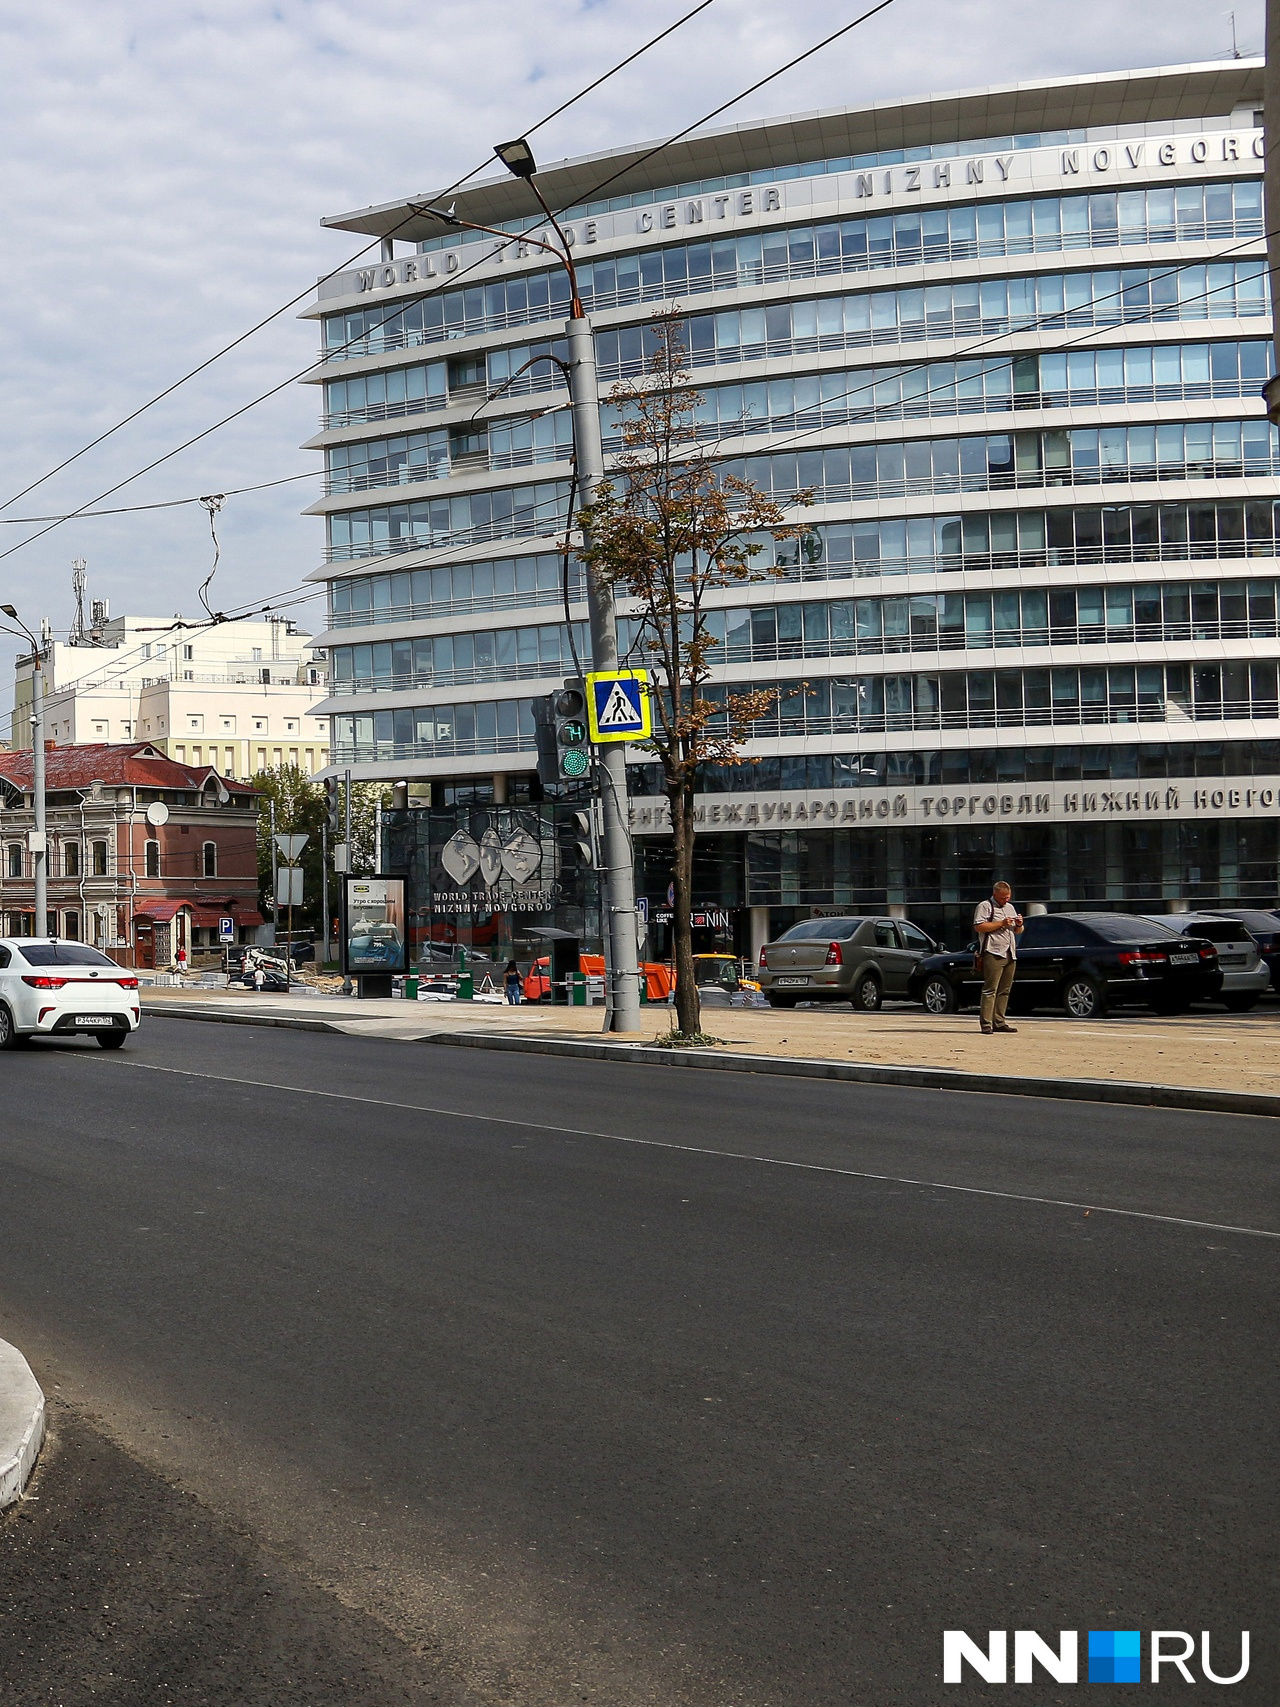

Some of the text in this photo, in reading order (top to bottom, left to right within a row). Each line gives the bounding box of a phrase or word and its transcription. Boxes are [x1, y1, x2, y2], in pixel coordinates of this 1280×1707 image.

[358, 252, 460, 293] WORLD
[494, 221, 599, 263] TRADE
[636, 187, 781, 234] CENTER
[857, 155, 1014, 198] NIZHNY
[564, 725, 582, 741] 74
[629, 785, 1280, 825] ЕНТ МЕЖДУНАРОДНОЙ ТОРГОВЛИ НИЖНИЙ НОВГО
[433, 890, 552, 902] WORLD TRADE CENTER
[433, 902, 552, 914] NIZHNY NOVGOROD
